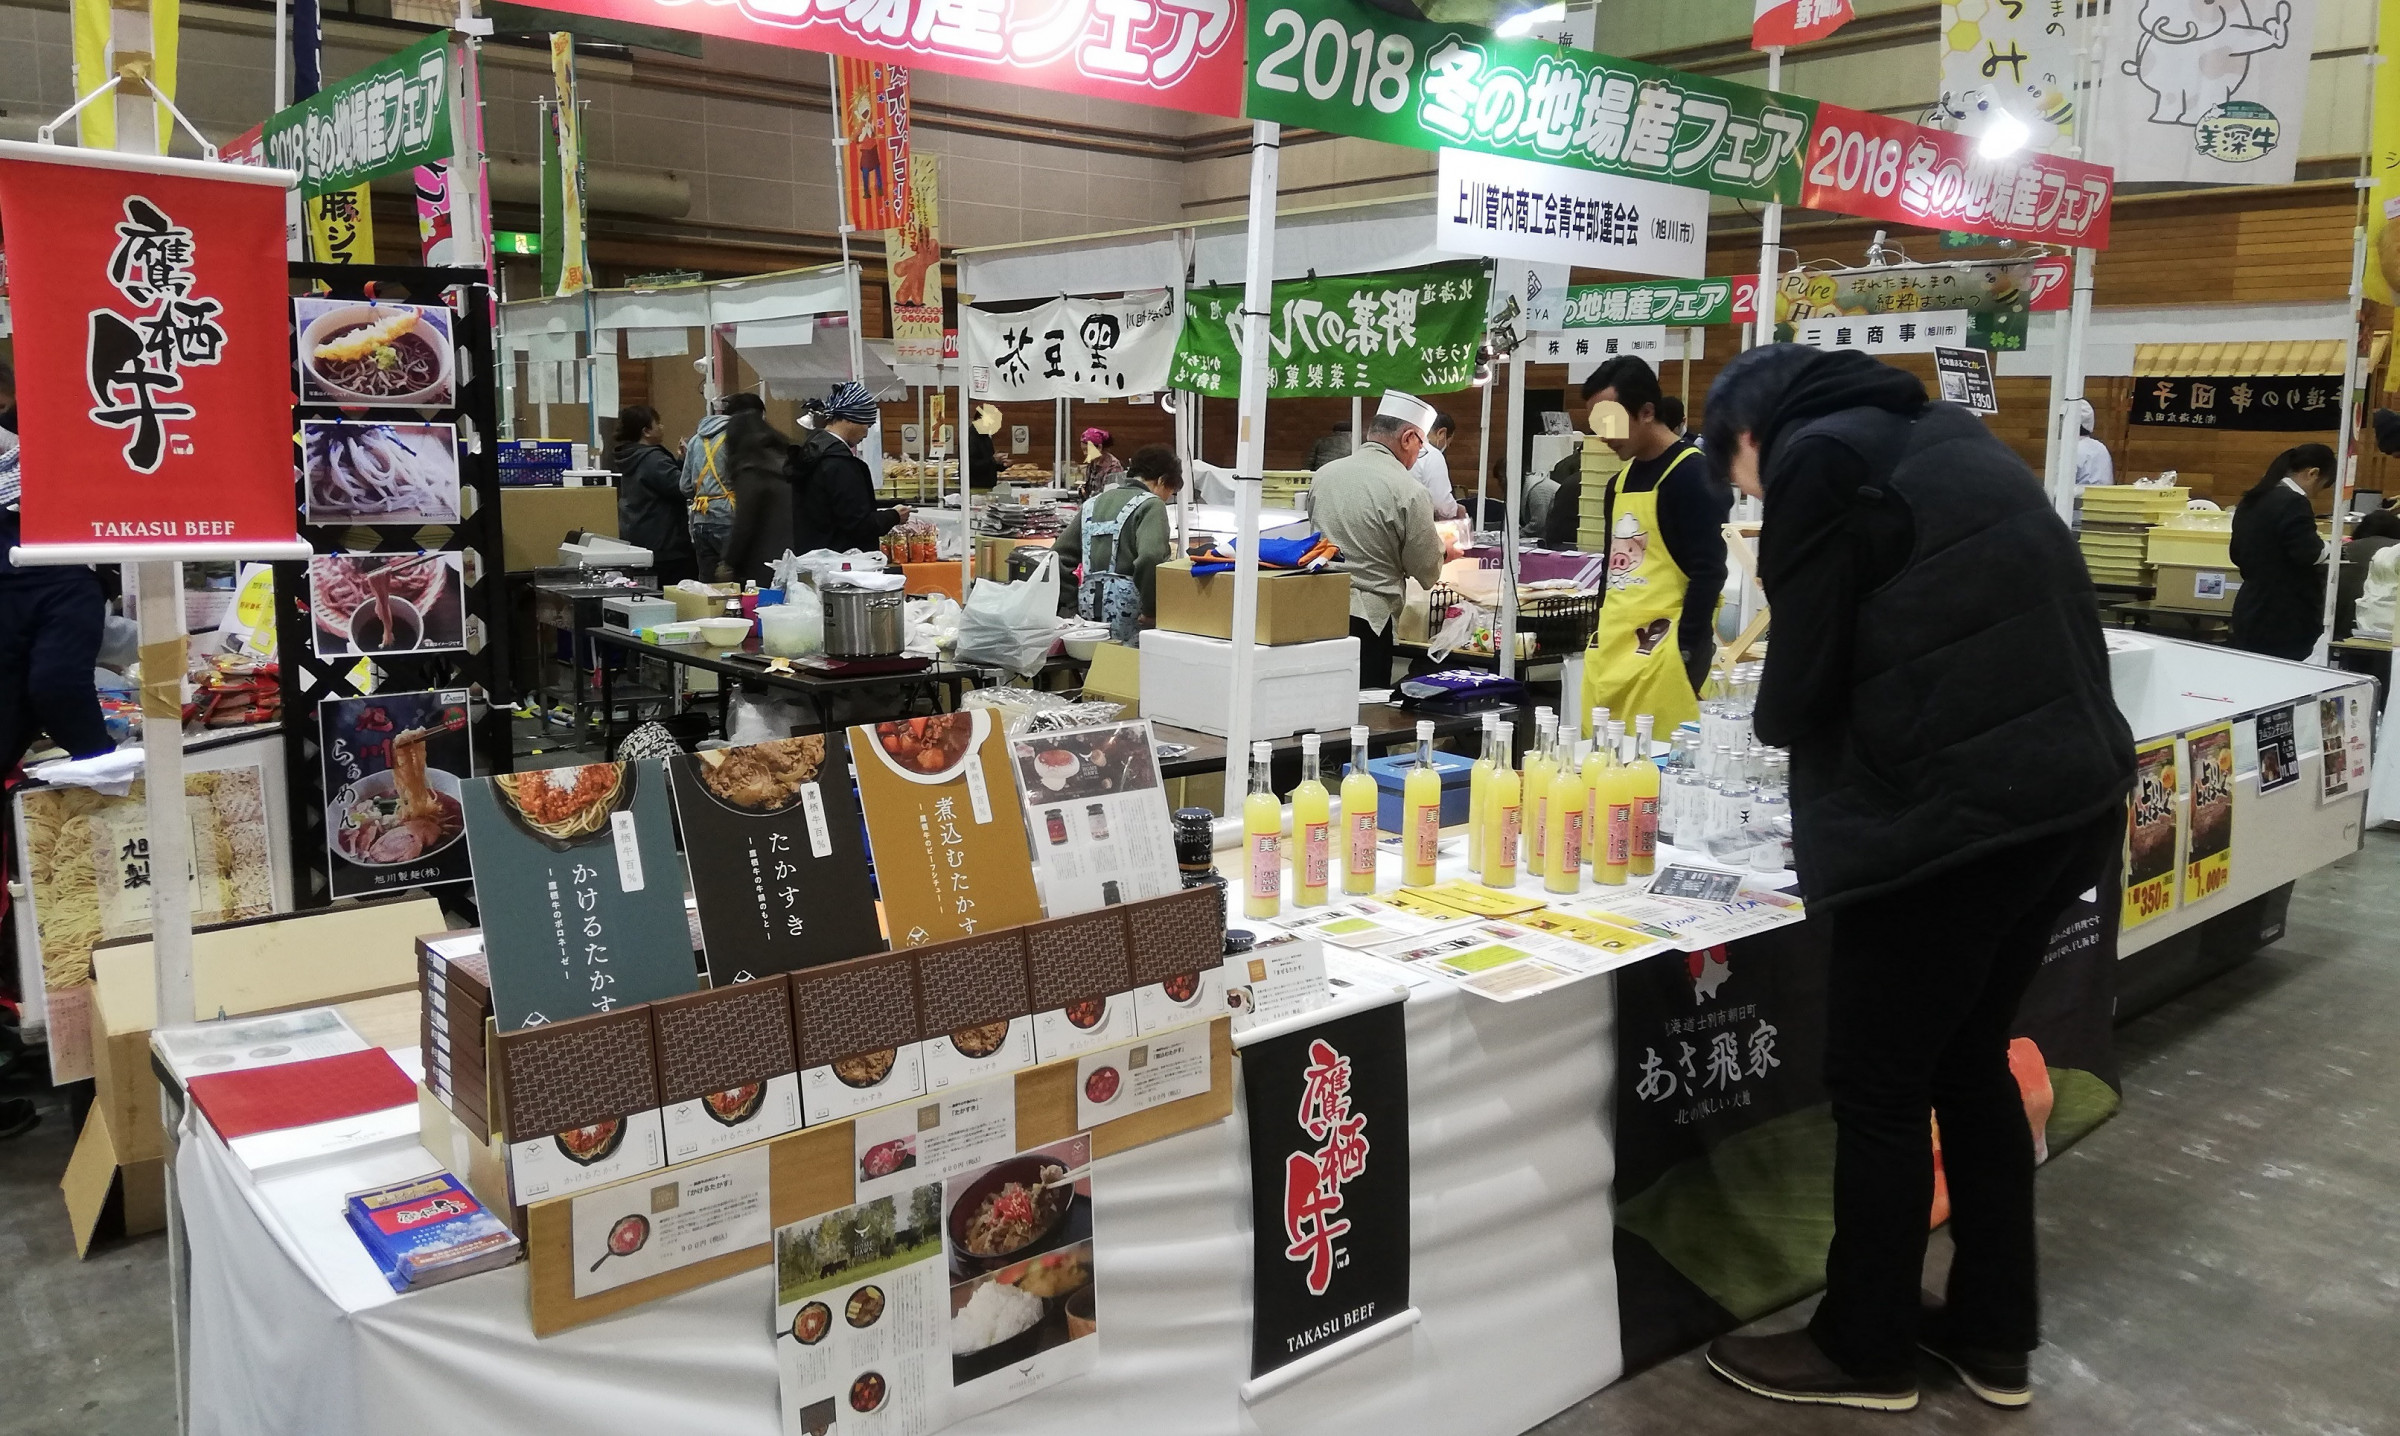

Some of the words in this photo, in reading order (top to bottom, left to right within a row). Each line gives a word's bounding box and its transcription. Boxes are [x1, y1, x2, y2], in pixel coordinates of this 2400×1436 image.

[305, 54, 444, 182] 冬の地場産フェア
[1255, 8, 1415, 114] 2018
[1421, 38, 1806, 188] 冬の地場産フェア
[2198, 123, 2276, 154] 美深牛
[319, 190, 360, 265] 豚ジ
[1453, 179, 1639, 246] 上川管内商工会青年部連合会
[1651, 215, 1695, 245] (旭川市)
[1809, 126, 1903, 198] 2018
[1902, 142, 2108, 236] 冬の地場産フェア
[91, 197, 226, 472] 鷹栖牛
[1785, 276, 1831, 300] Pure
[1806, 323, 1917, 346] 三皇商事
[1924, 325, 1958, 338] (旭川市)
[91, 521, 178, 537] TAKASU
[184, 520, 236, 536] BEEF
[768, 833, 805, 938] たかすき
[934, 797, 978, 935] 煮込むたかす
[572, 863, 617, 1013] かけるたかす
[1636, 1018, 1781, 1103] あさ飛家
[1284, 1038, 1369, 1297] 鷹栖牛
[1286, 1321, 1342, 1354] TAKASU
[1342, 1302, 1377, 1331] BEEF
